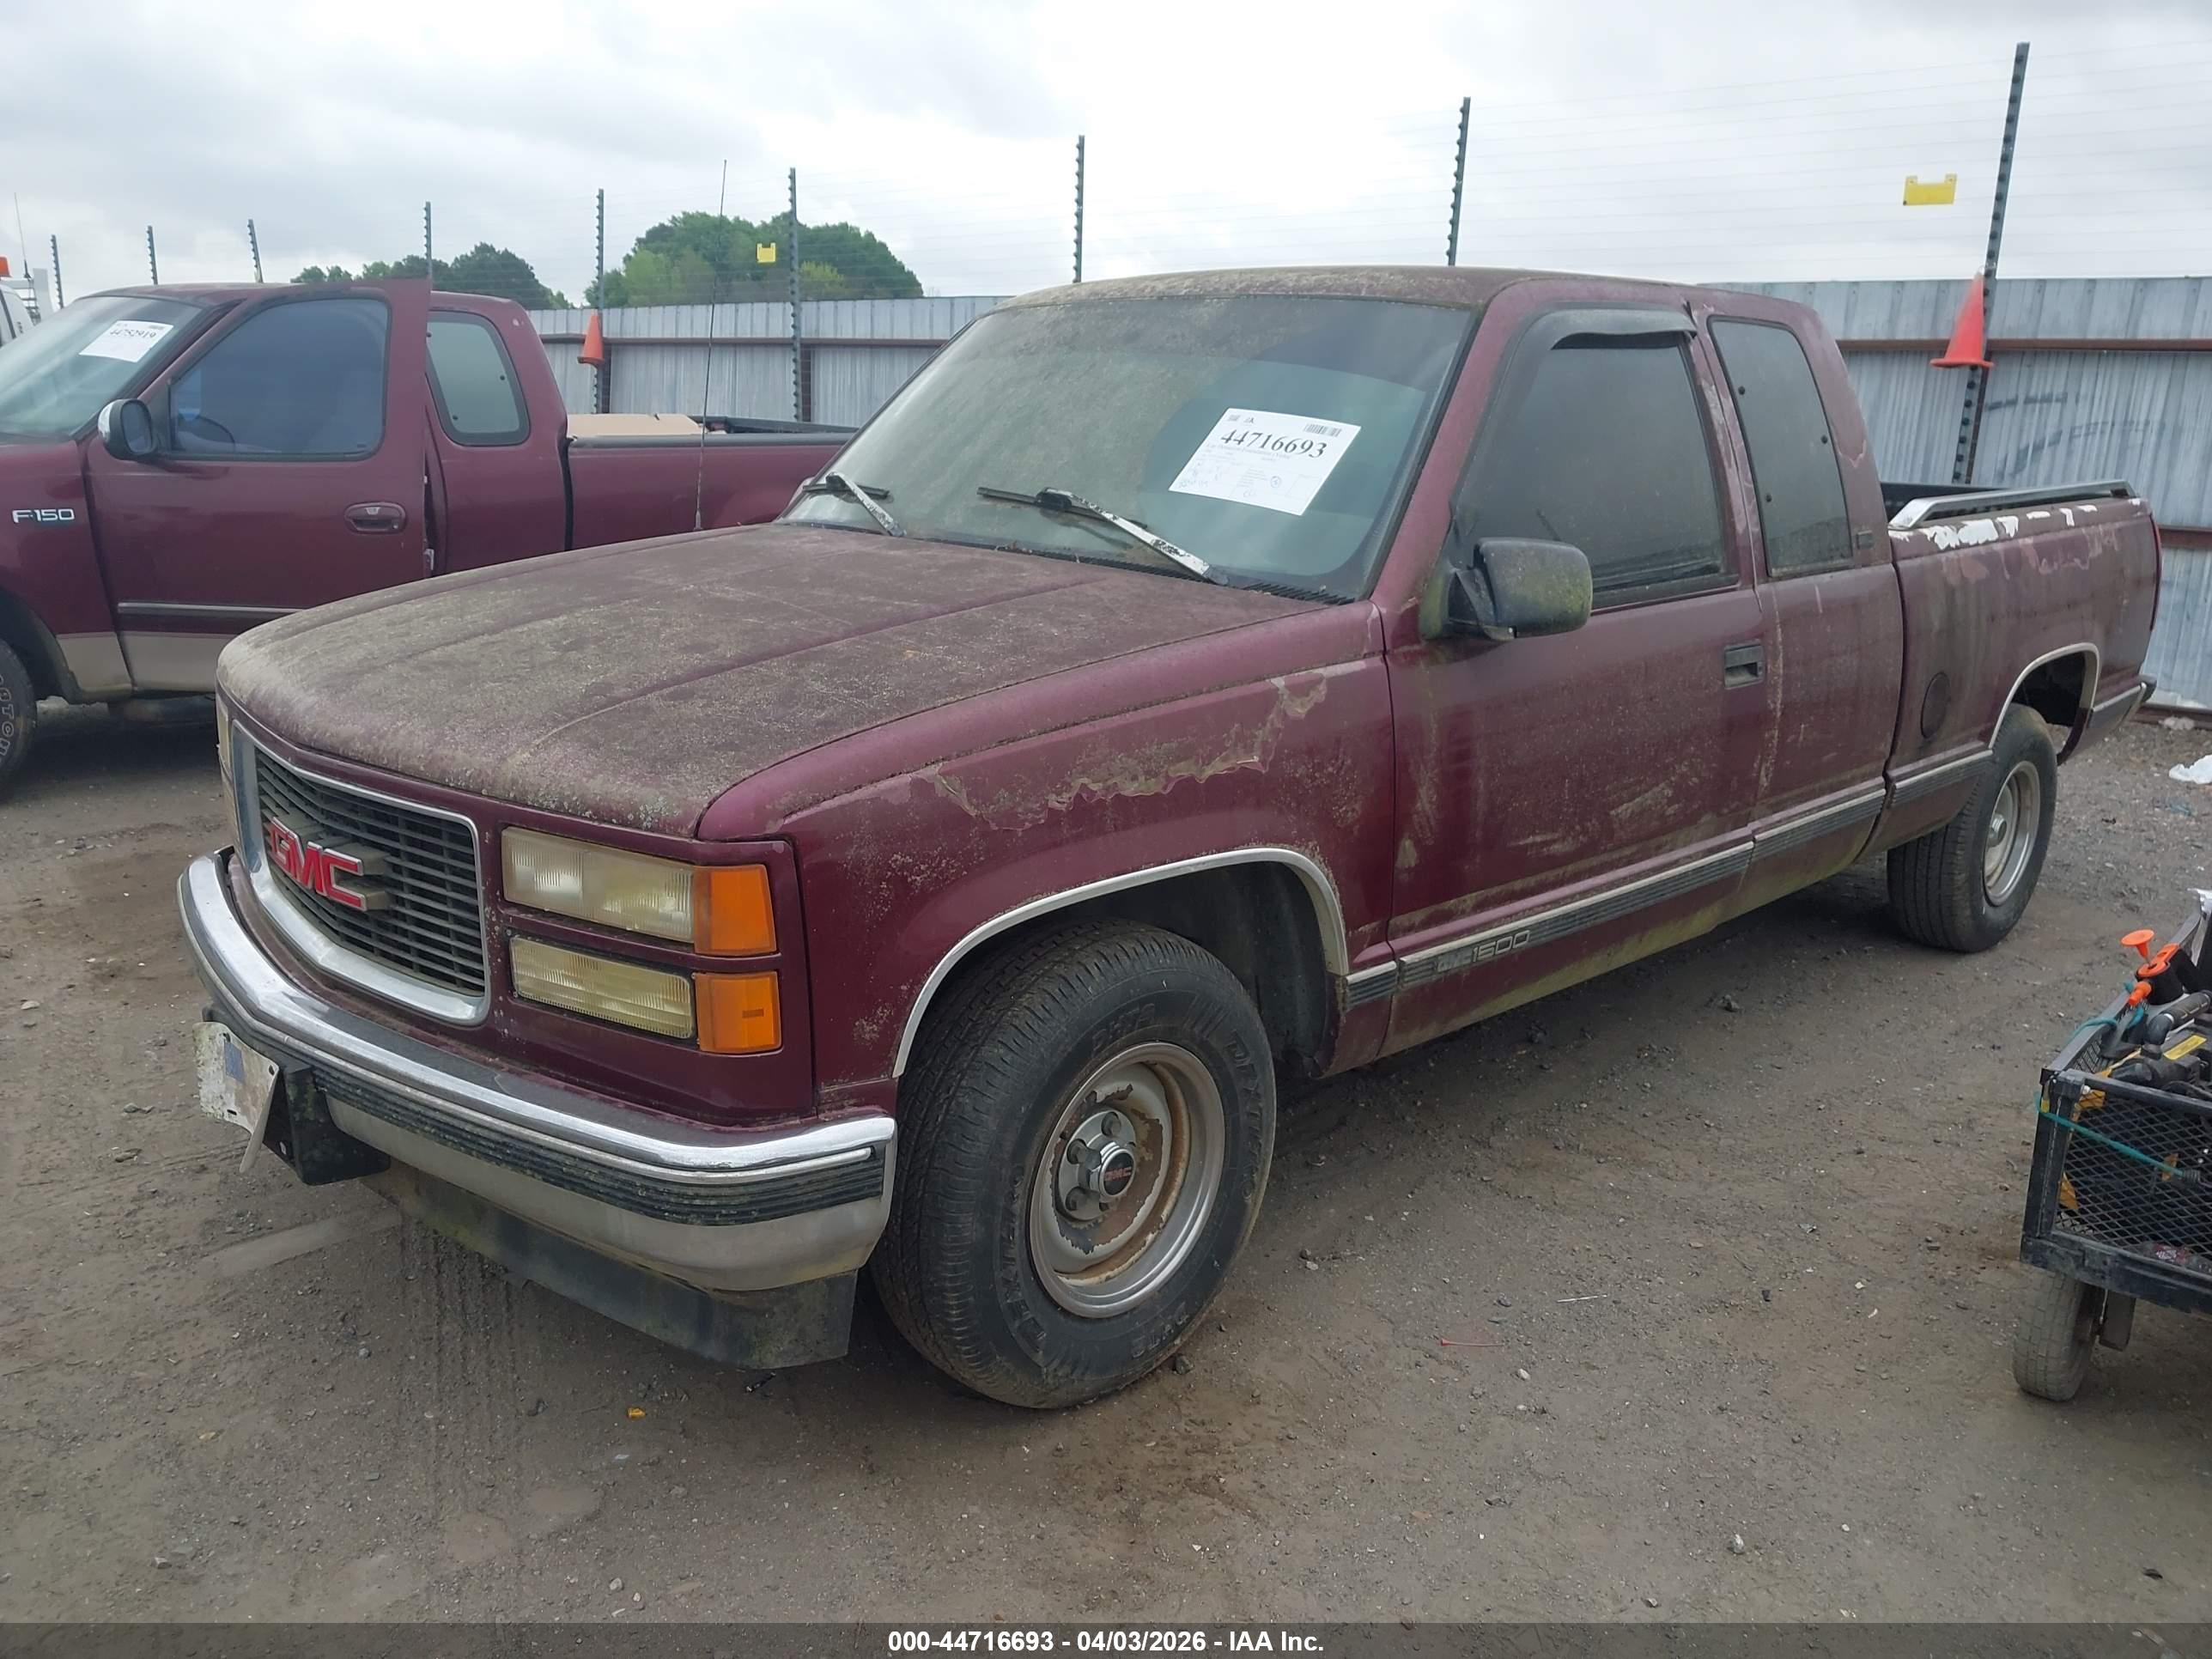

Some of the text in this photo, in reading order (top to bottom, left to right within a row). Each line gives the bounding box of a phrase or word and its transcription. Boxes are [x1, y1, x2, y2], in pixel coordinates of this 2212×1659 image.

[1220, 429, 1328, 459] 44716693
[265, 816, 368, 912] GMC
[1472, 929, 1531, 963] 1500
